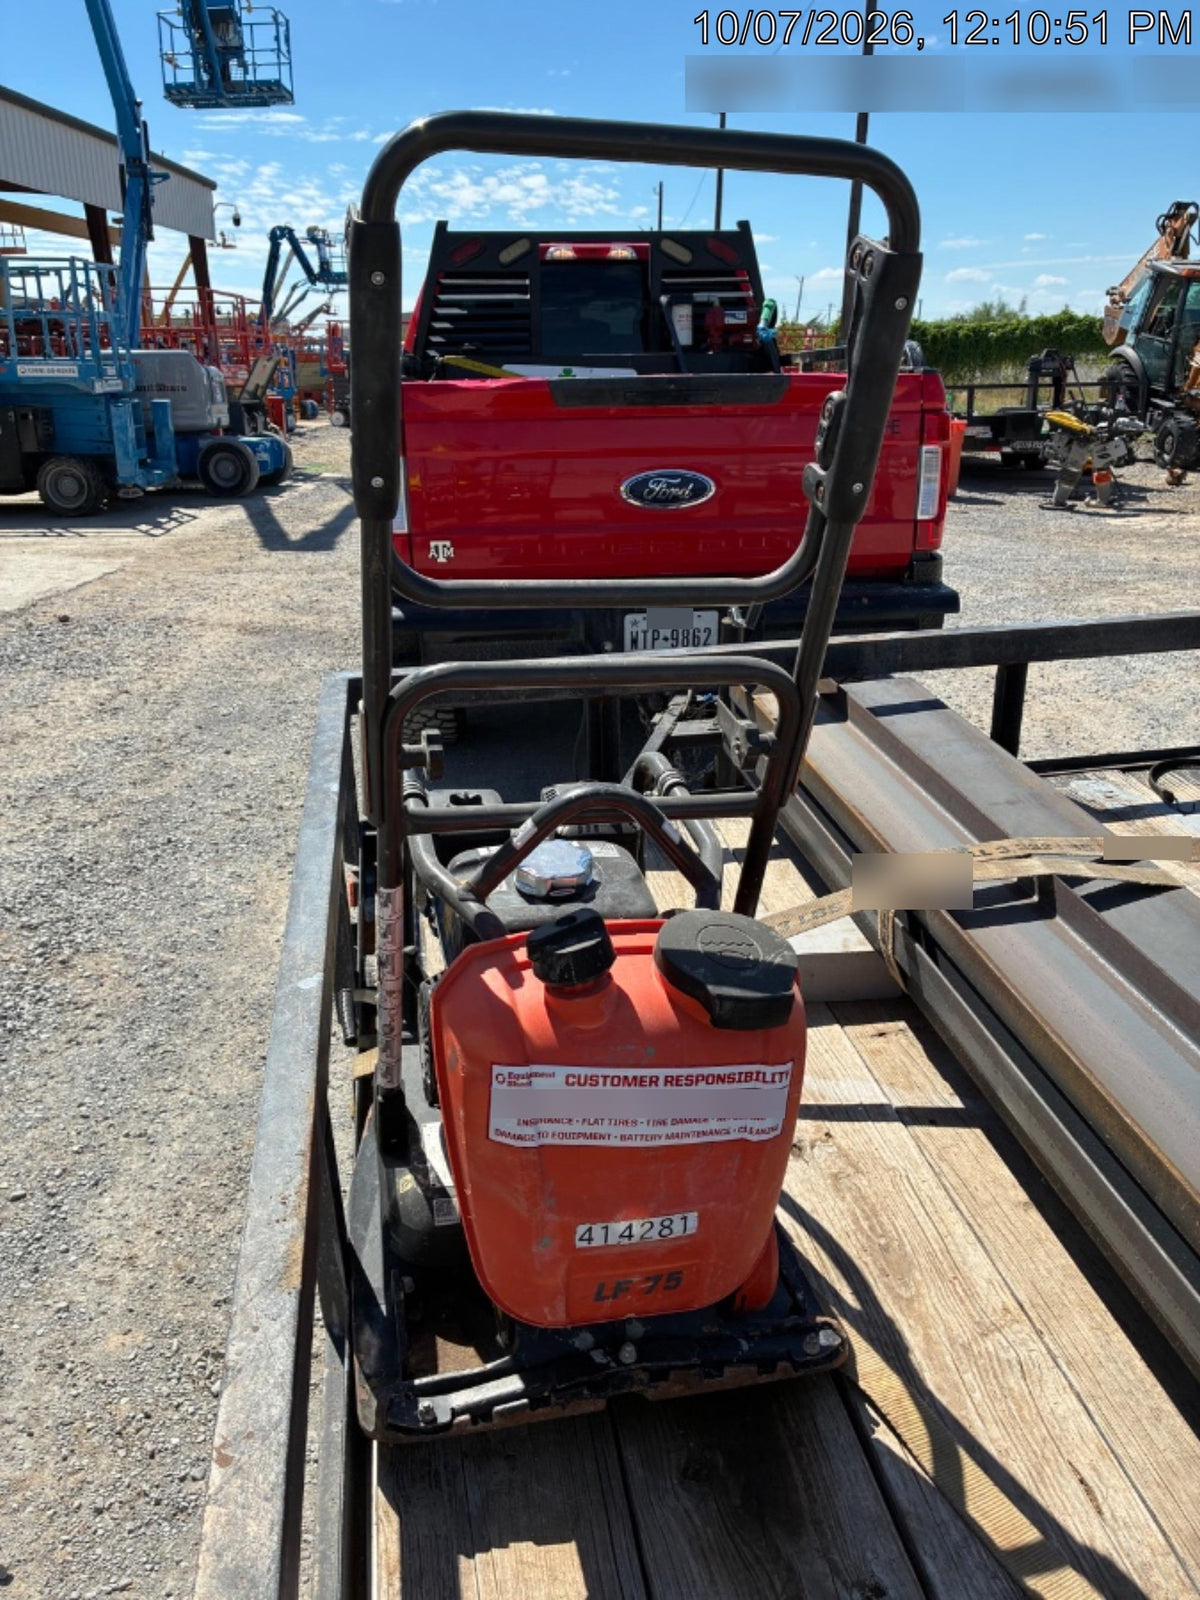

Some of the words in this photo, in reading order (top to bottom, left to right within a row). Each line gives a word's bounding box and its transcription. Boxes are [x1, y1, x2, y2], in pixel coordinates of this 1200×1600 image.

[643, 477, 694, 500] Ford
[564, 1073, 659, 1087] CUSTOMER
[581, 1118, 606, 1127] FLAT
[608, 1118, 637, 1128] TIRES
[537, 1130, 549, 1140] TO
[551, 1131, 613, 1141] EQUIPMENT
[619, 1133, 662, 1142] BATTERY
[664, 1128, 731, 1141] MAINTENANCE
[577, 1214, 688, 1246] 414281
[592, 1279, 634, 1302] LF
[643, 1269, 684, 1295] 75
